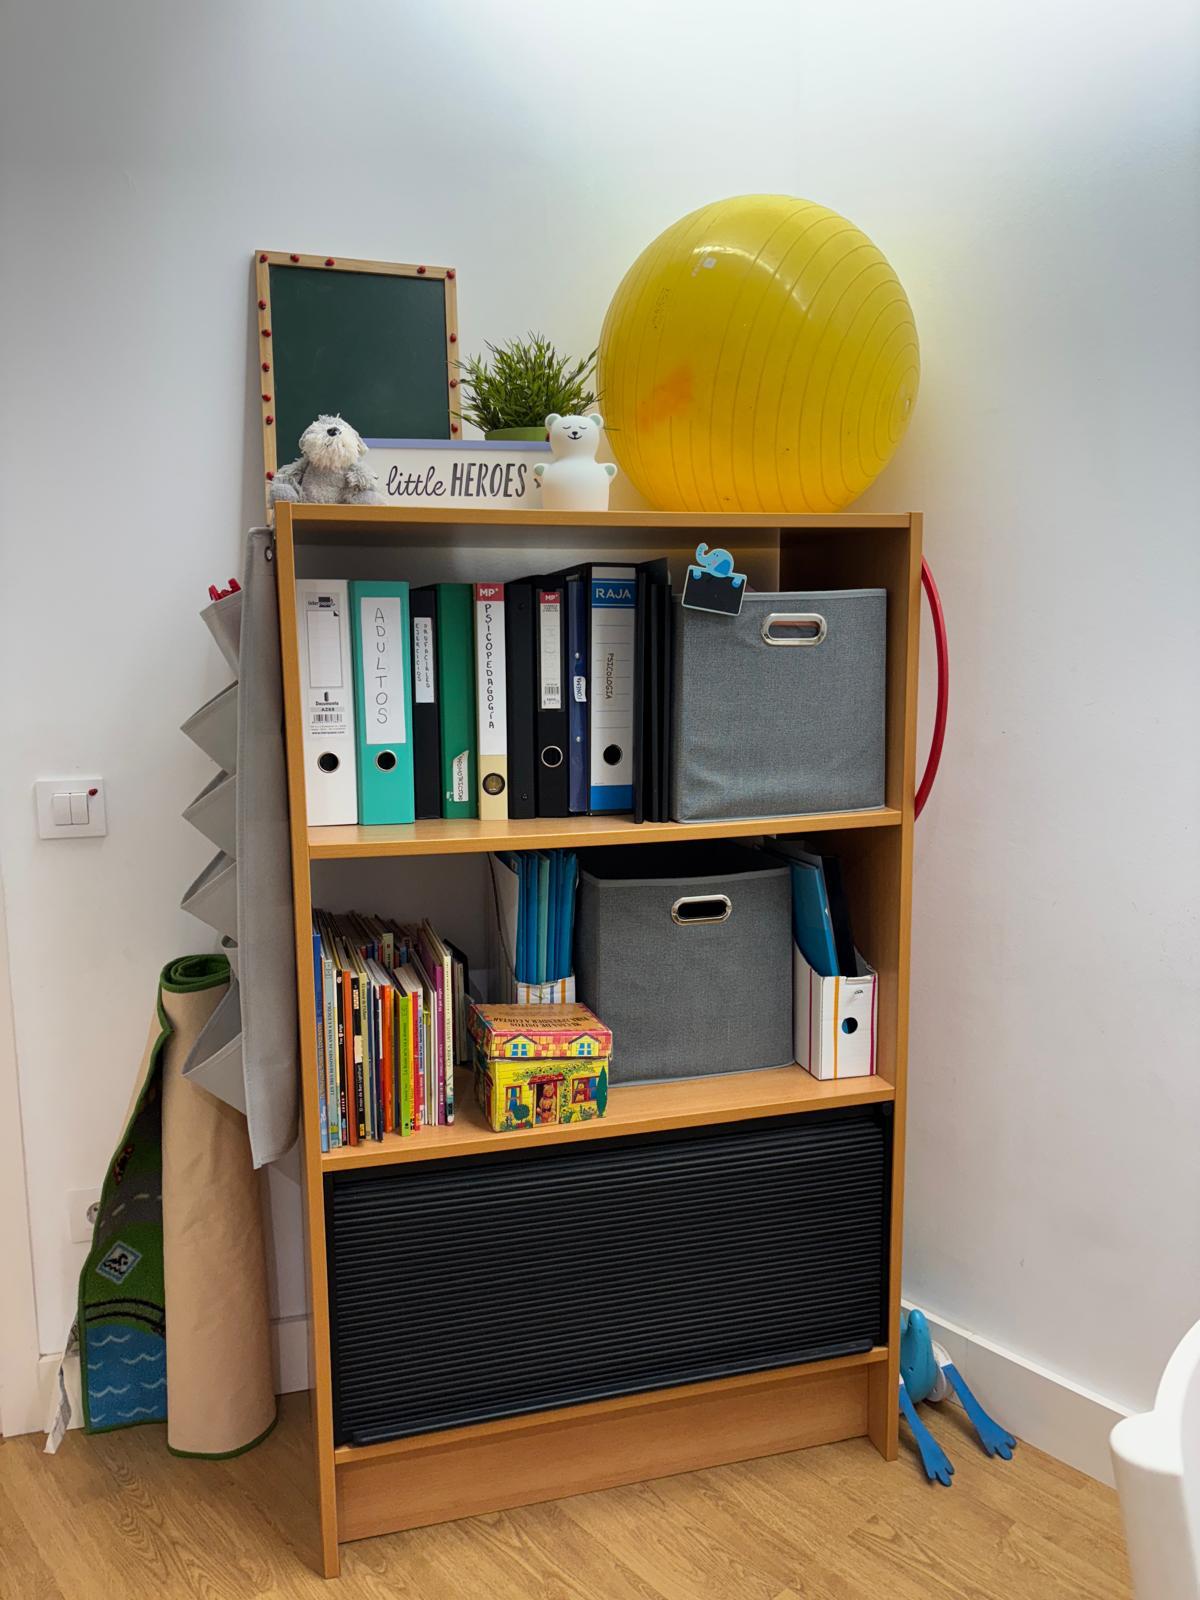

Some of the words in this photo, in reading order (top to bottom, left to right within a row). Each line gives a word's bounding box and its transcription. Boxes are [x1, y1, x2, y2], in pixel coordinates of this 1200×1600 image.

[385, 465, 447, 496] little
[450, 462, 527, 498] HEROES
[595, 587, 632, 599] RAJA
[374, 607, 389, 725] ADULTOS
